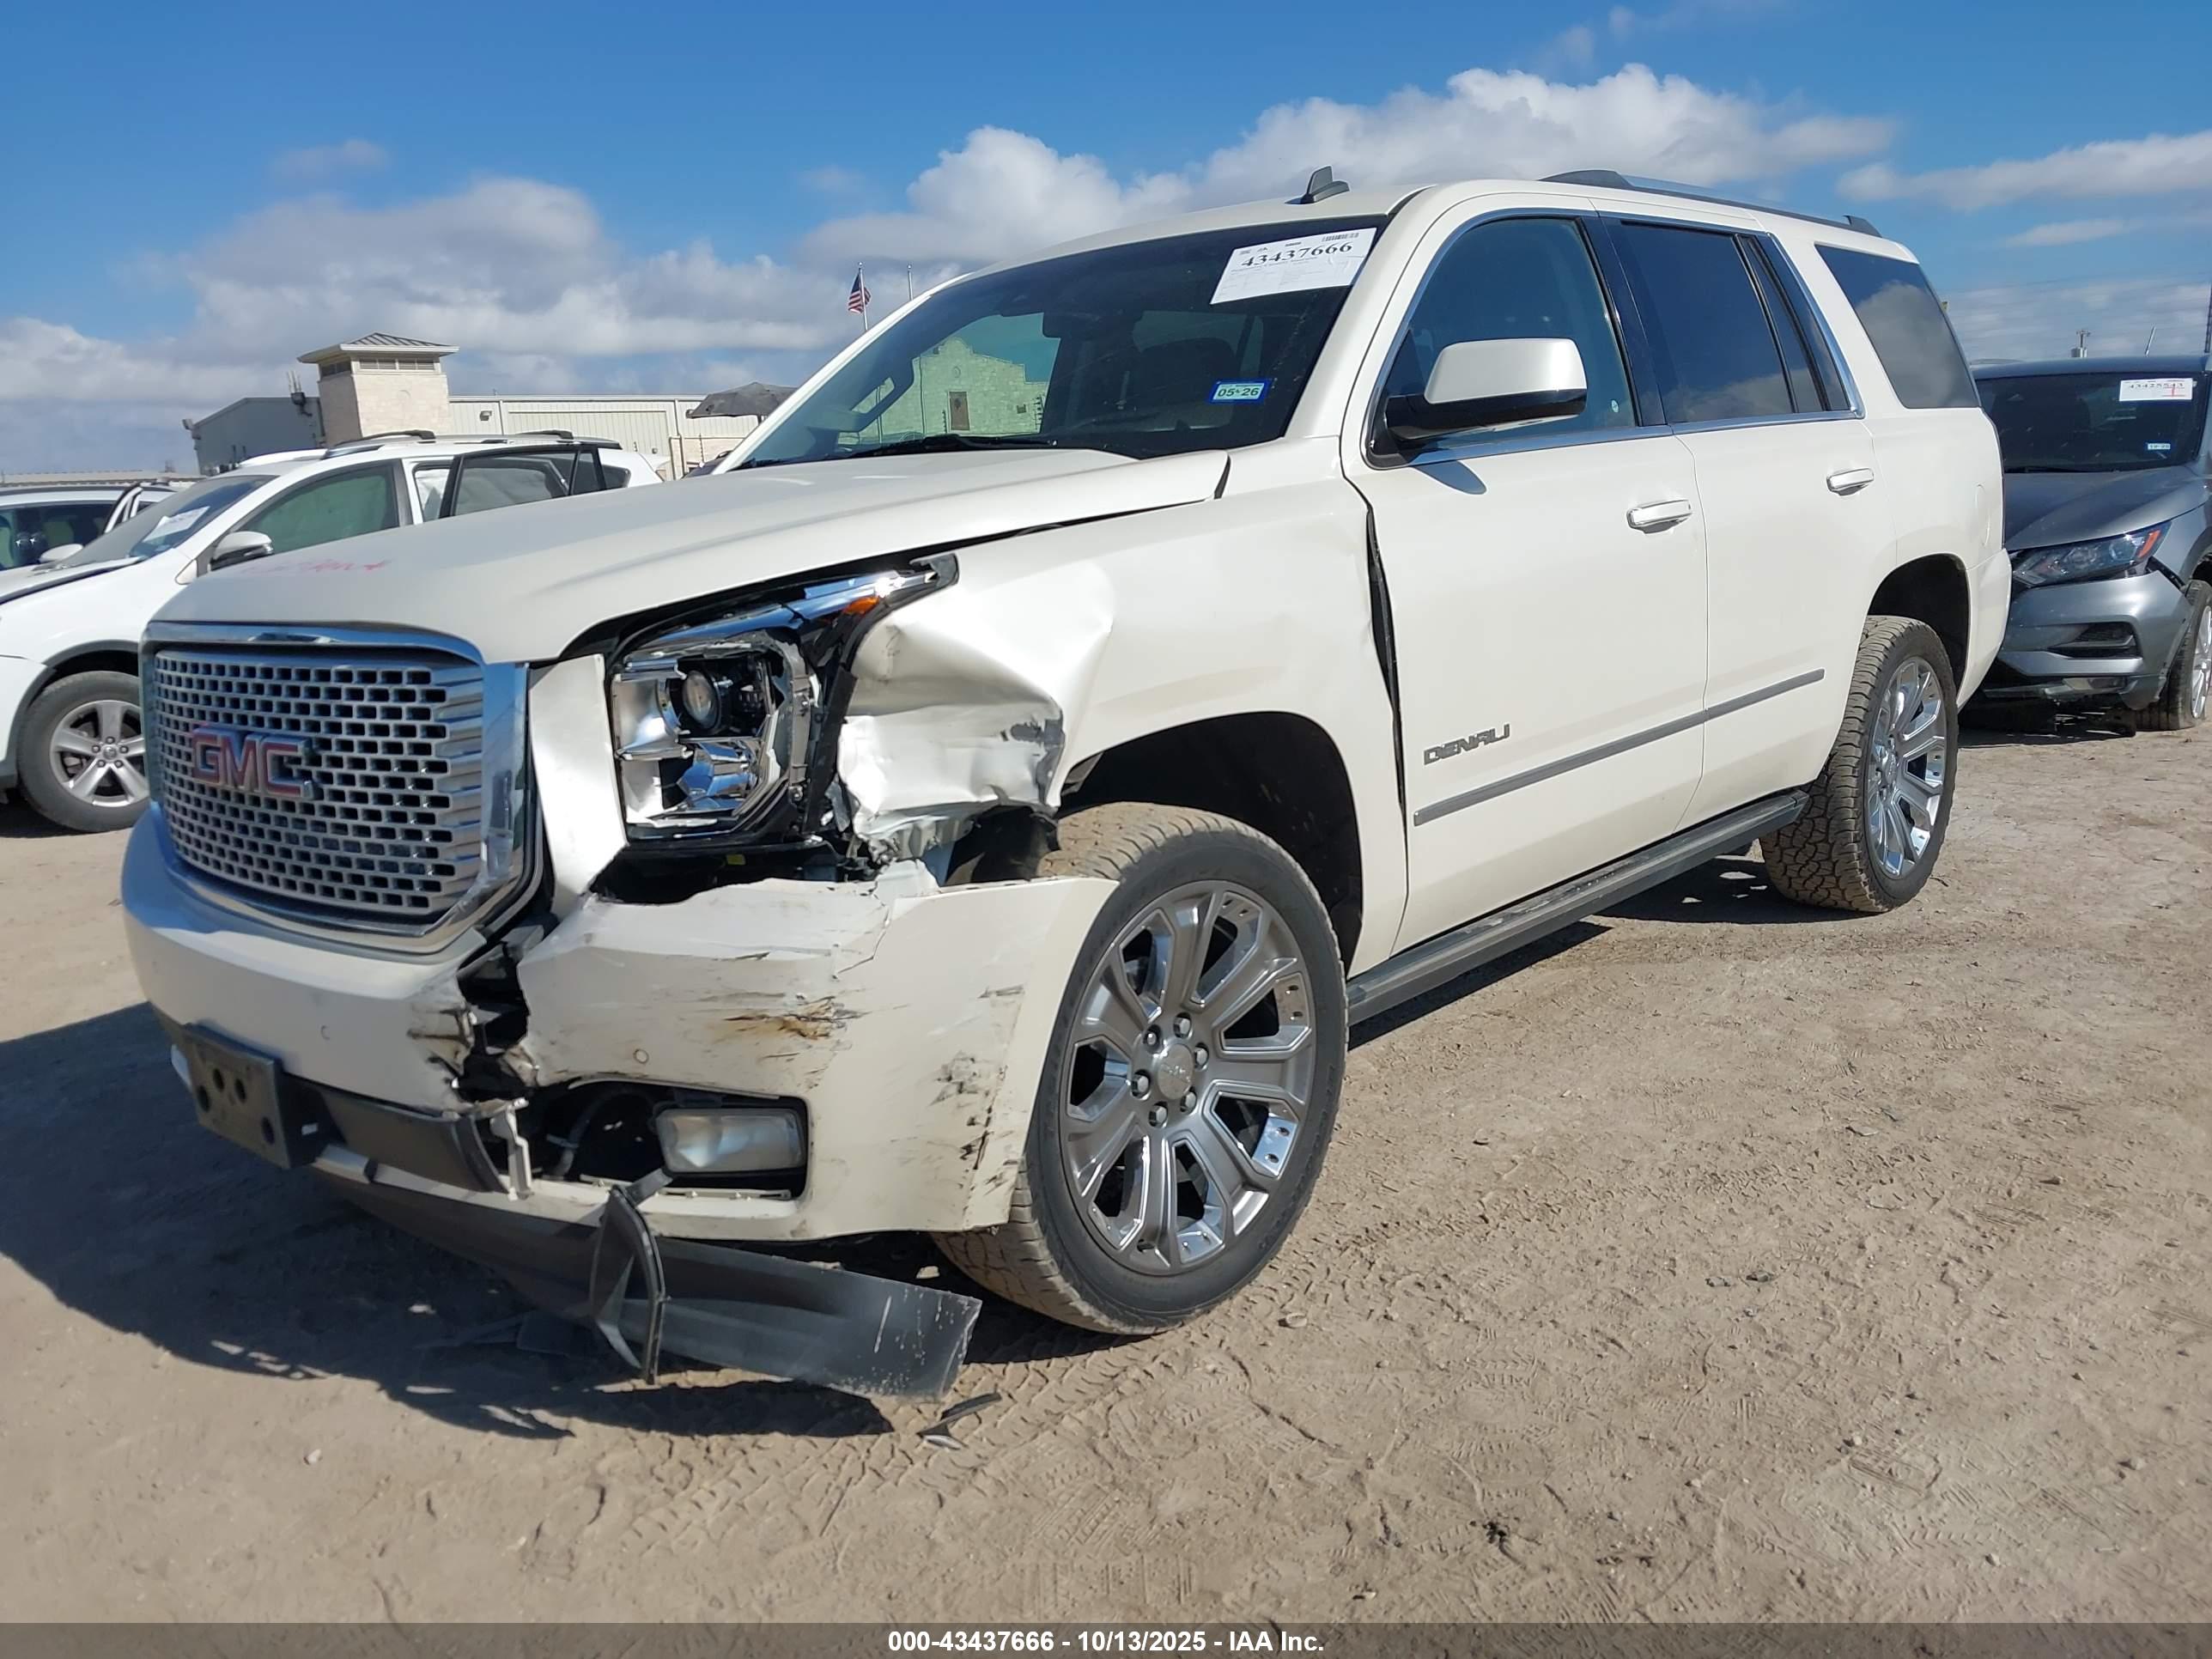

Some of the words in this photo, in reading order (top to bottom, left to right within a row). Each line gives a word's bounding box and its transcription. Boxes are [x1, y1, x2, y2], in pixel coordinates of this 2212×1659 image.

[1241, 241, 1352, 266] 43437666
[191, 727, 313, 799] GMC
[1424, 723, 1510, 765] DENALI
